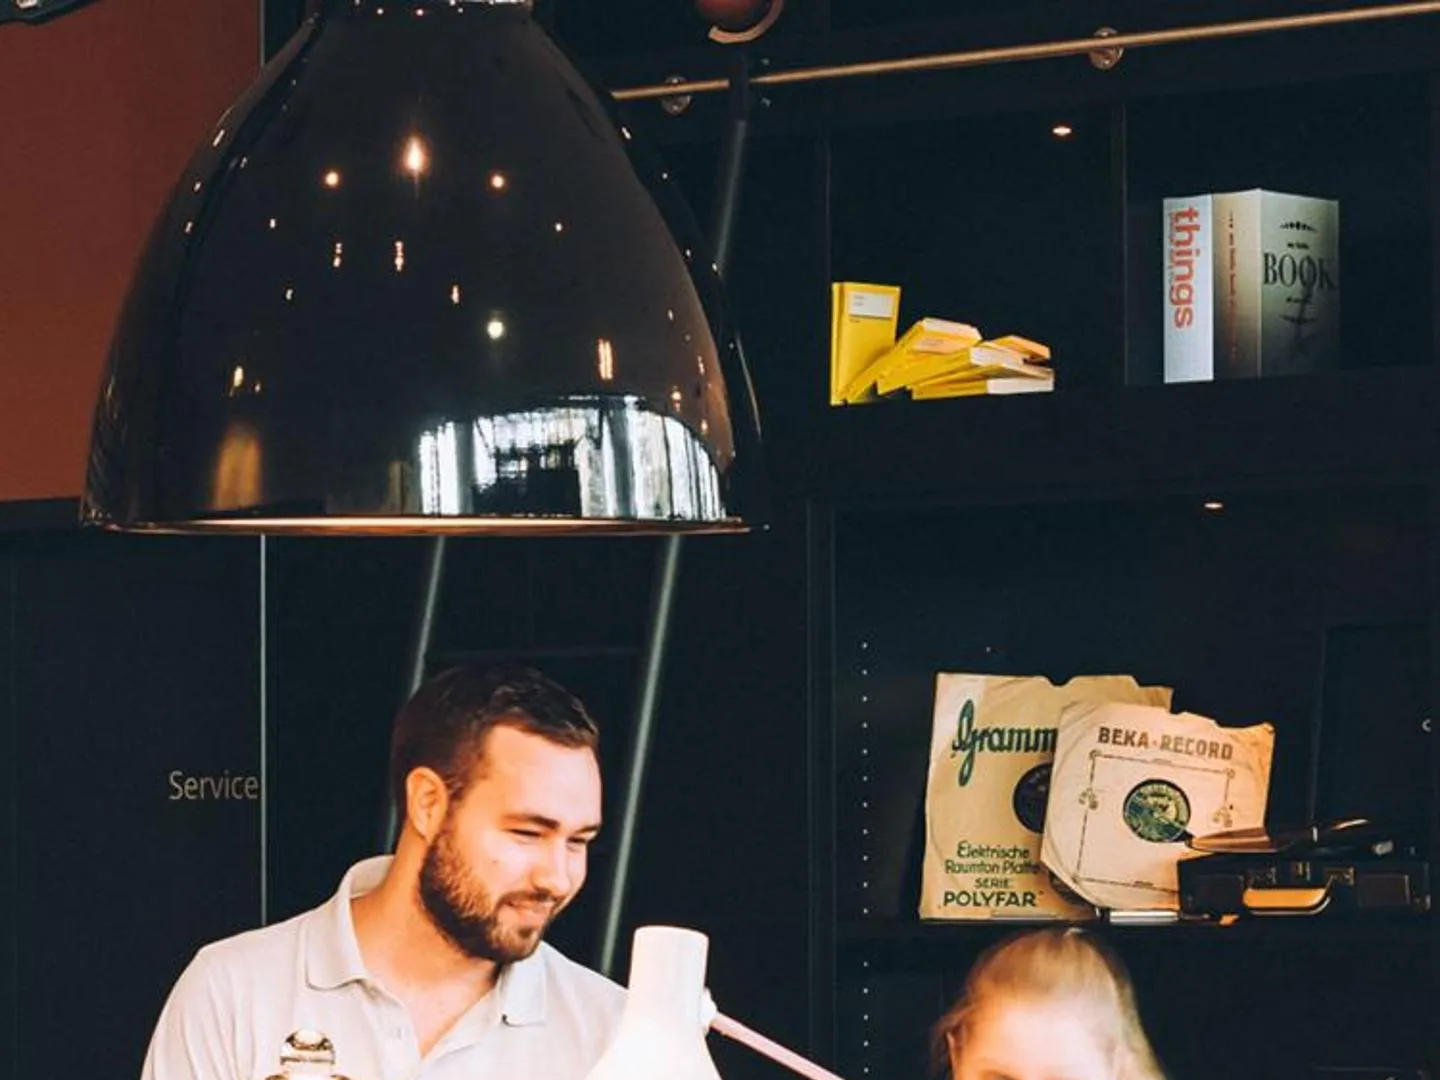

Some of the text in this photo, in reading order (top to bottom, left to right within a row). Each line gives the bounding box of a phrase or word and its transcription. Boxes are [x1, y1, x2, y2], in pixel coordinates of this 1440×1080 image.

[1169, 206, 1200, 329] things
[1263, 252, 1337, 290] BOOK
[168, 768, 259, 800] Service
